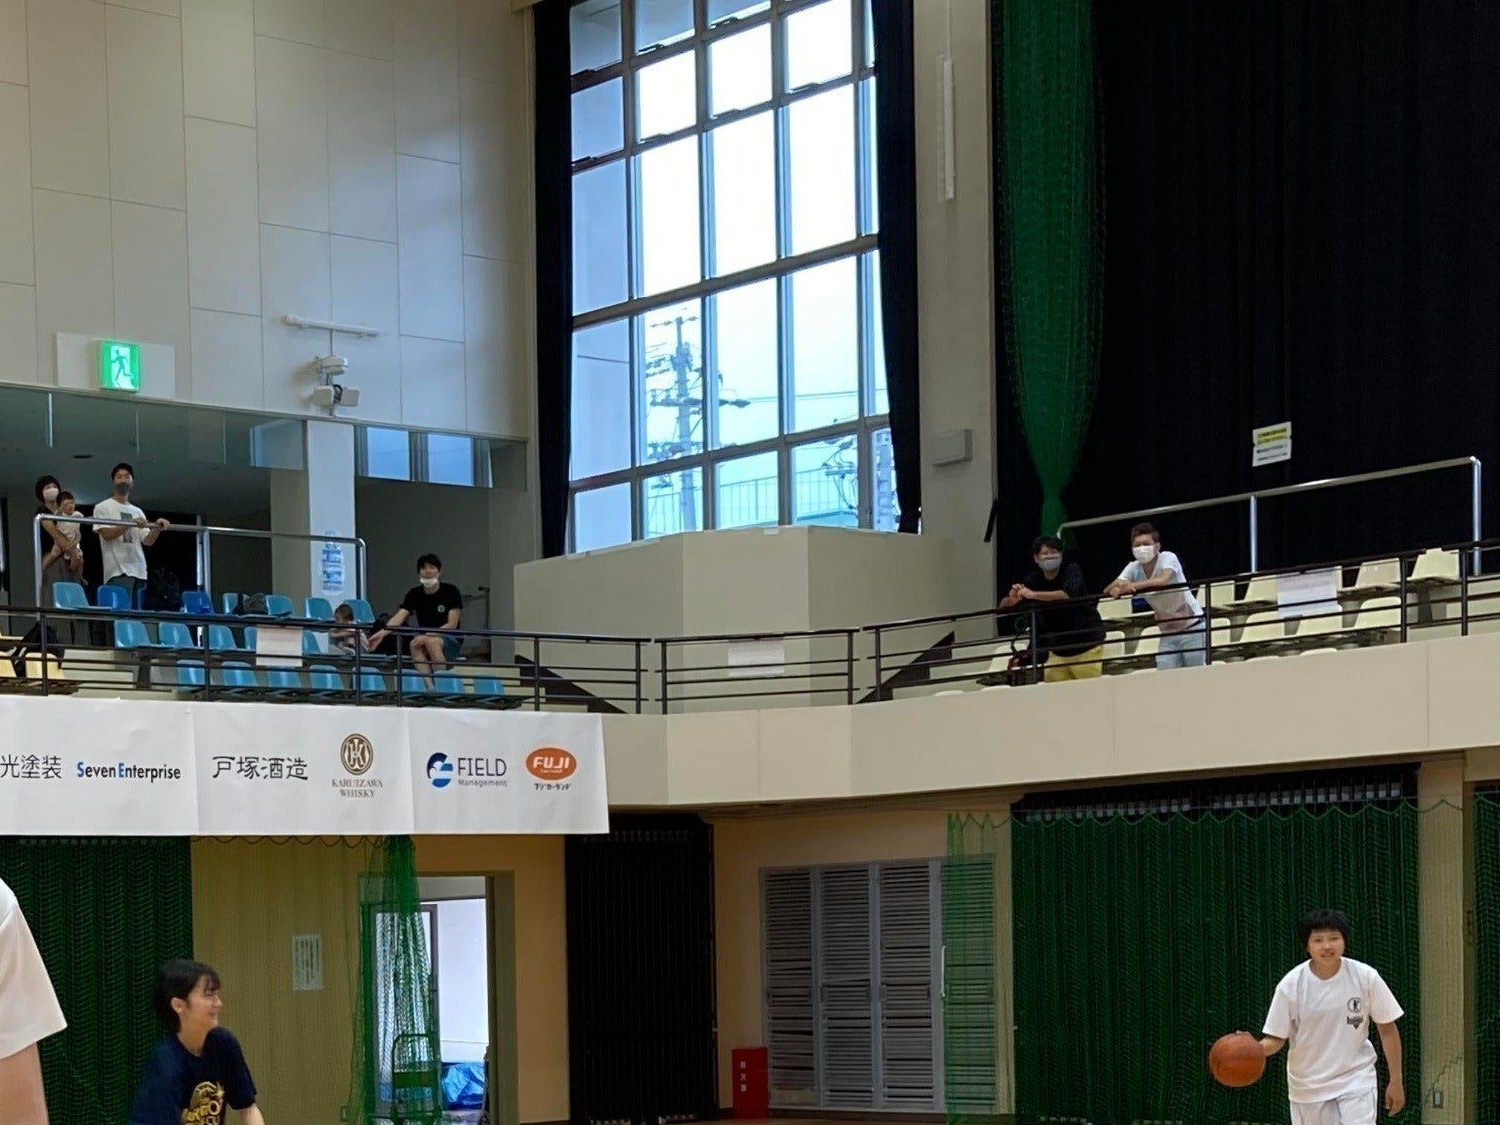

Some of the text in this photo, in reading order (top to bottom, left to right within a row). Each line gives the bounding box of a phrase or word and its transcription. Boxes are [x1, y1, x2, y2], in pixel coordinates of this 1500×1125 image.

[212, 756, 309, 781] 戸塚酒造
[458, 758, 507, 777] FIELD
[533, 756, 570, 769] FUJI
